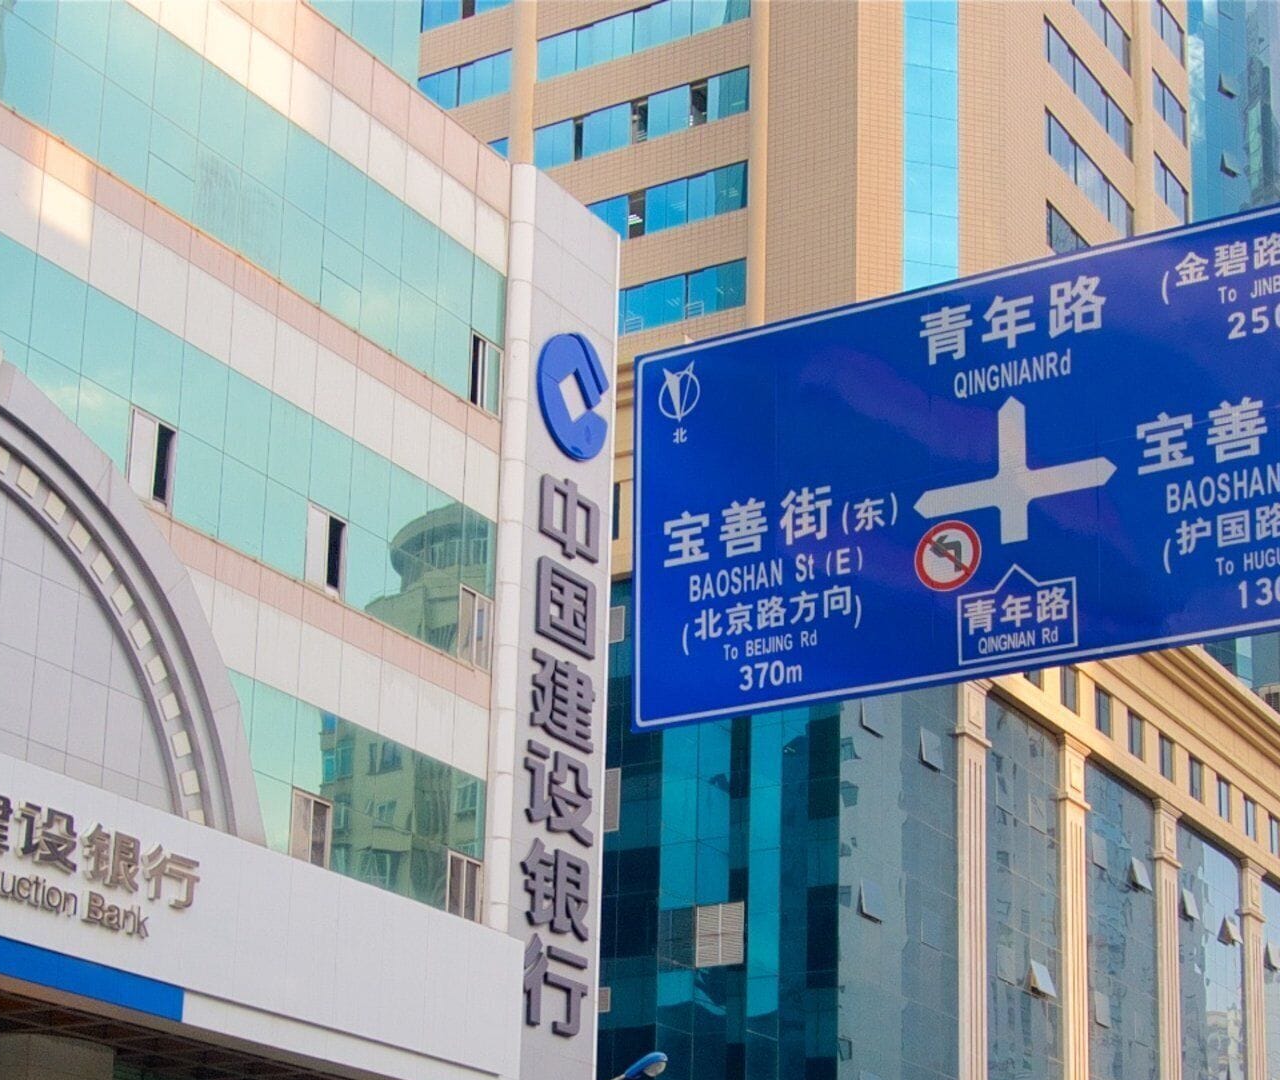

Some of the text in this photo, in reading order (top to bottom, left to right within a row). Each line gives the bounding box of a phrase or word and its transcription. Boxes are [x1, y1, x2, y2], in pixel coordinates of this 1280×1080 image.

[1218, 286, 1237, 304] To
[919, 275, 1107, 366] 青年路
[672, 427, 688, 444] 北
[1166, 462, 1280, 514] BAOSHAN
[689, 546, 863, 603] BAOSHAN St (E)
[1215, 556, 1234, 577] To
[682, 584, 862, 656] (北京路方向)
[963, 586, 1070, 636] 青年路
[723, 628, 818, 662] To BEIJING Rd
[977, 625, 1059, 654] QINGNIAN Rd
[739, 660, 803, 692] 370m
[520, 472, 599, 1039] 中国建设银行
[82, 889, 151, 938] Bank
